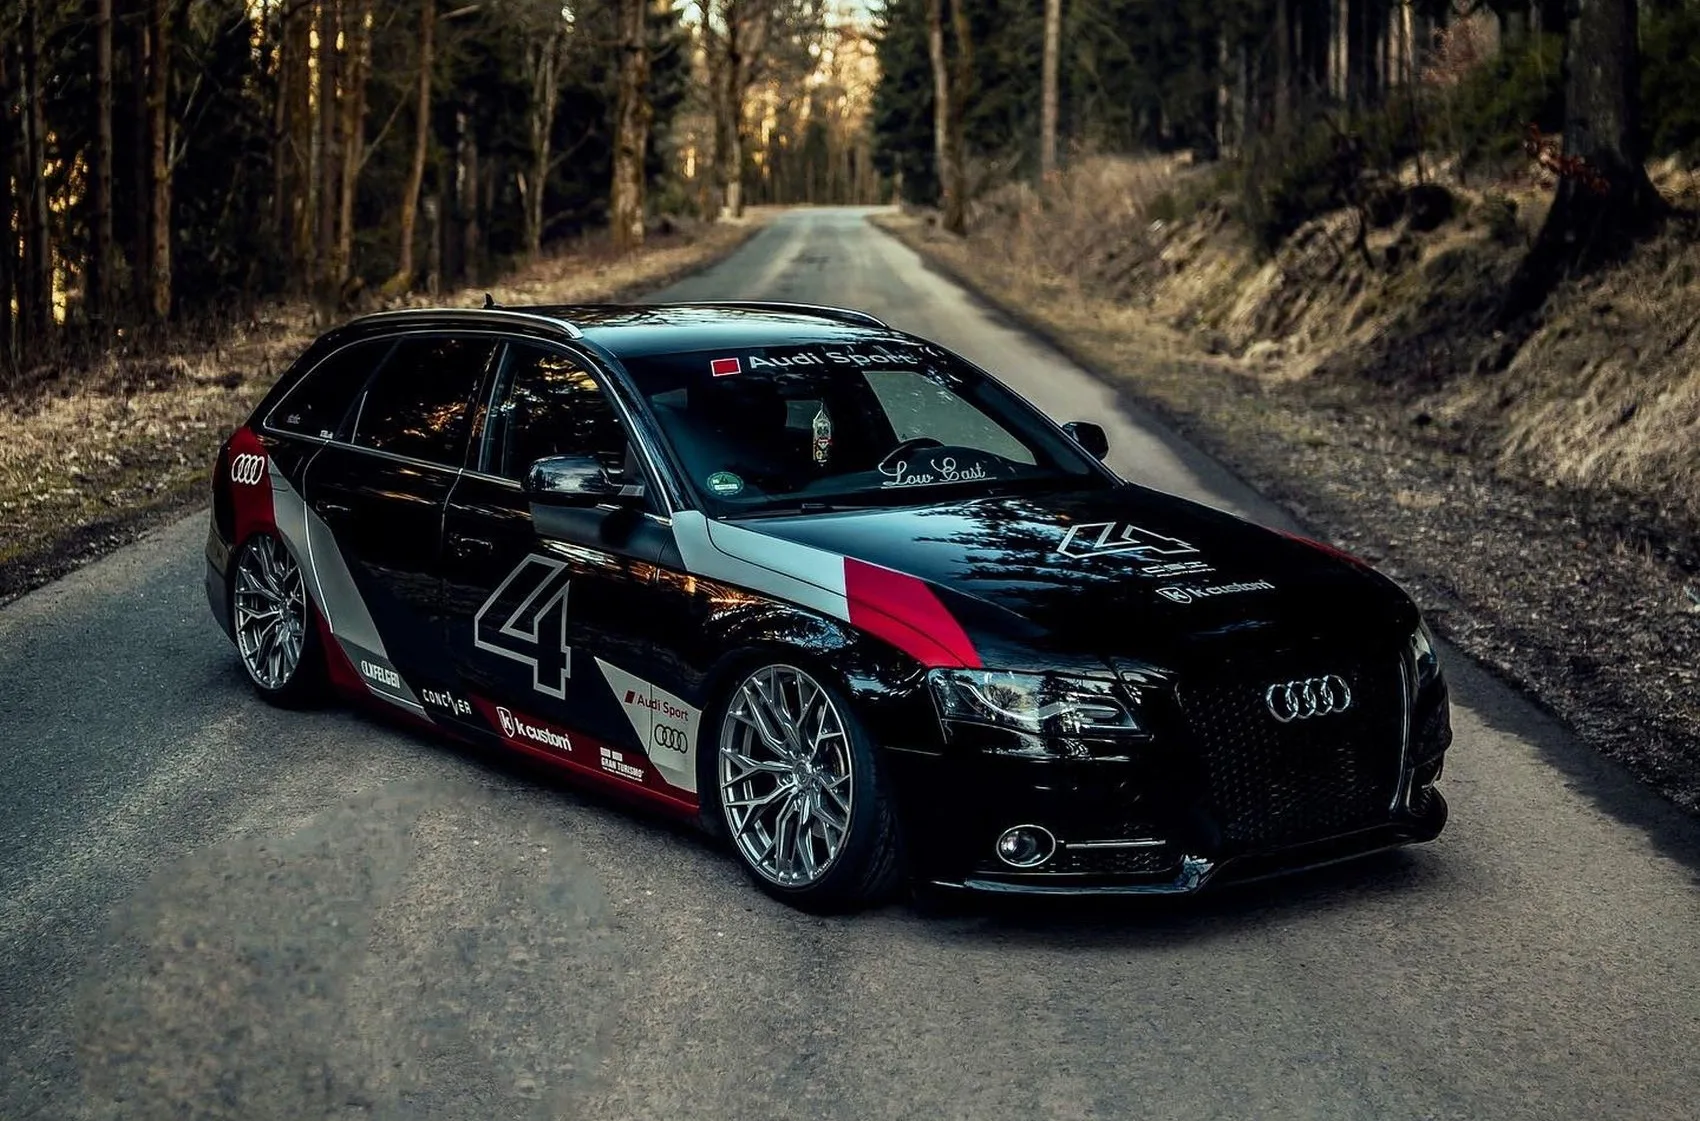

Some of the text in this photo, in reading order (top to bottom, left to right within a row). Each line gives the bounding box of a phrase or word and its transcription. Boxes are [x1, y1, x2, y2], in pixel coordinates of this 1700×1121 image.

[749, 351, 920, 369] Audi Sport
[878, 461, 934, 485] Low
[474, 553, 571, 700] 4
[422, 688, 473, 716] CONCAVER
[637, 694, 689, 721] Audi Sport
[514, 717, 573, 752] k custom
